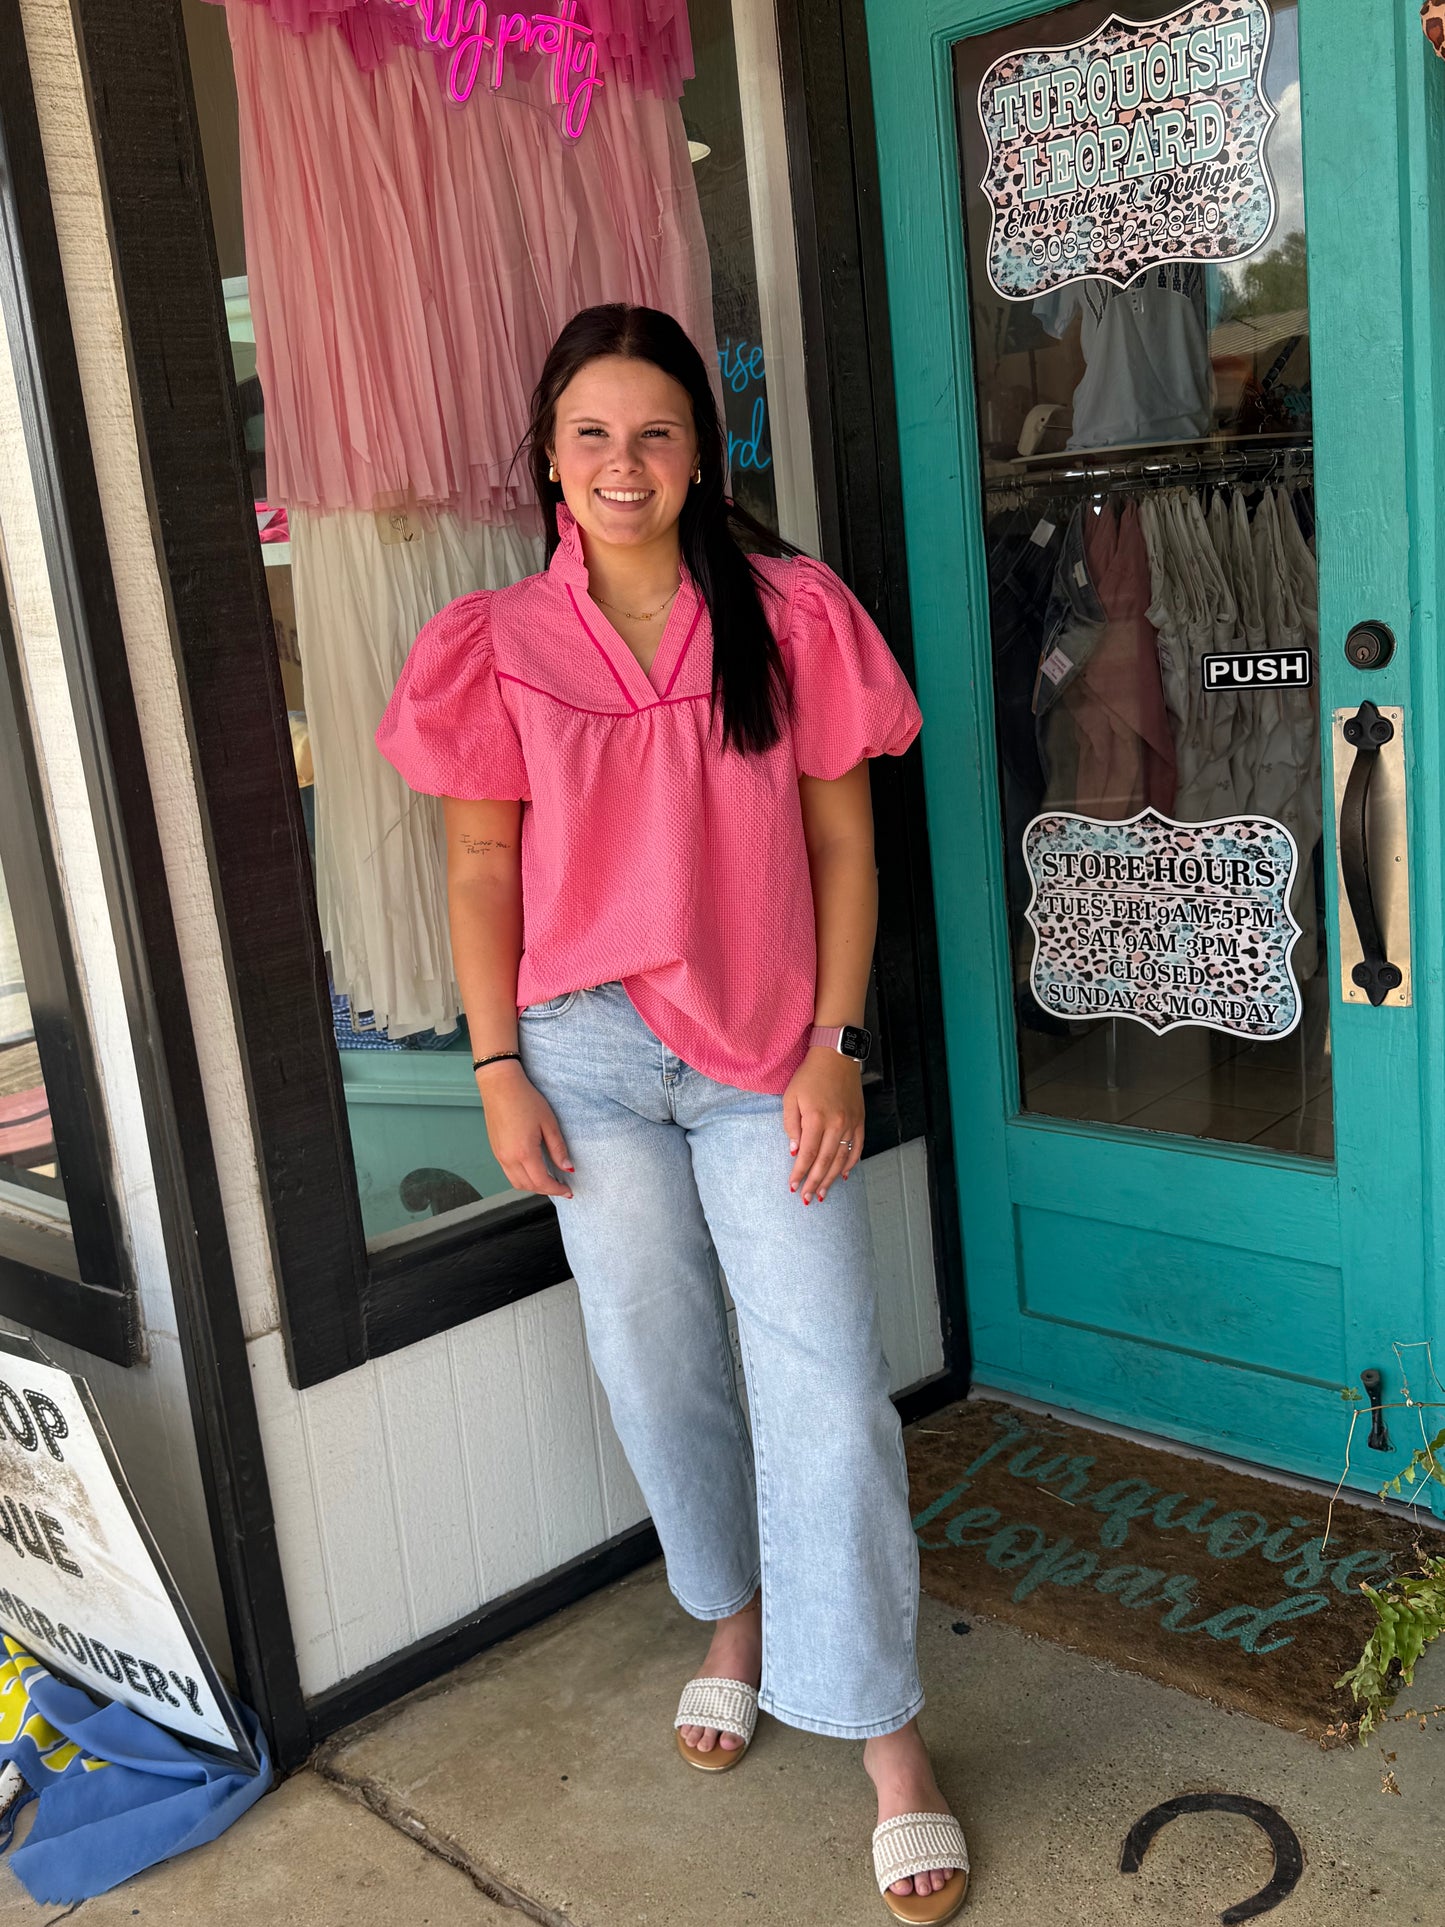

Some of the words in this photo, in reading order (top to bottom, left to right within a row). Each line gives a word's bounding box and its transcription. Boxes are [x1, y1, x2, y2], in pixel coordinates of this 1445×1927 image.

[490, 0, 604, 138] pretty
[994, 15, 1251, 141] TURQUOISE
[1020, 100, 1226, 202] LEOPARD
[1004, 190, 1121, 238] Embroidery
[1127, 180, 1145, 211] &
[1150, 162, 1251, 209] Boutique
[1031, 202, 1220, 266] 903-852-2840
[717, 336, 765, 392] ise
[1208, 656, 1303, 683] PUSH
[1041, 853, 1146, 882] STORE
[1153, 858, 1276, 889] HOURS
[1045, 896, 1156, 922] TUES-FRI
[1157, 904, 1275, 929] 9AM-5PM
[1077, 928, 1119, 950] SAT
[1125, 932, 1239, 959] 9AM-3PM
[1109, 959, 1206, 986] CLOSED
[1048, 984, 1138, 1010] SUNDAY
[1144, 994, 1164, 1013] &
[1169, 995, 1279, 1025] MONDAY
[0, 1379, 69, 1462] OP
[963, 1413, 1397, 1596] Turquoise
